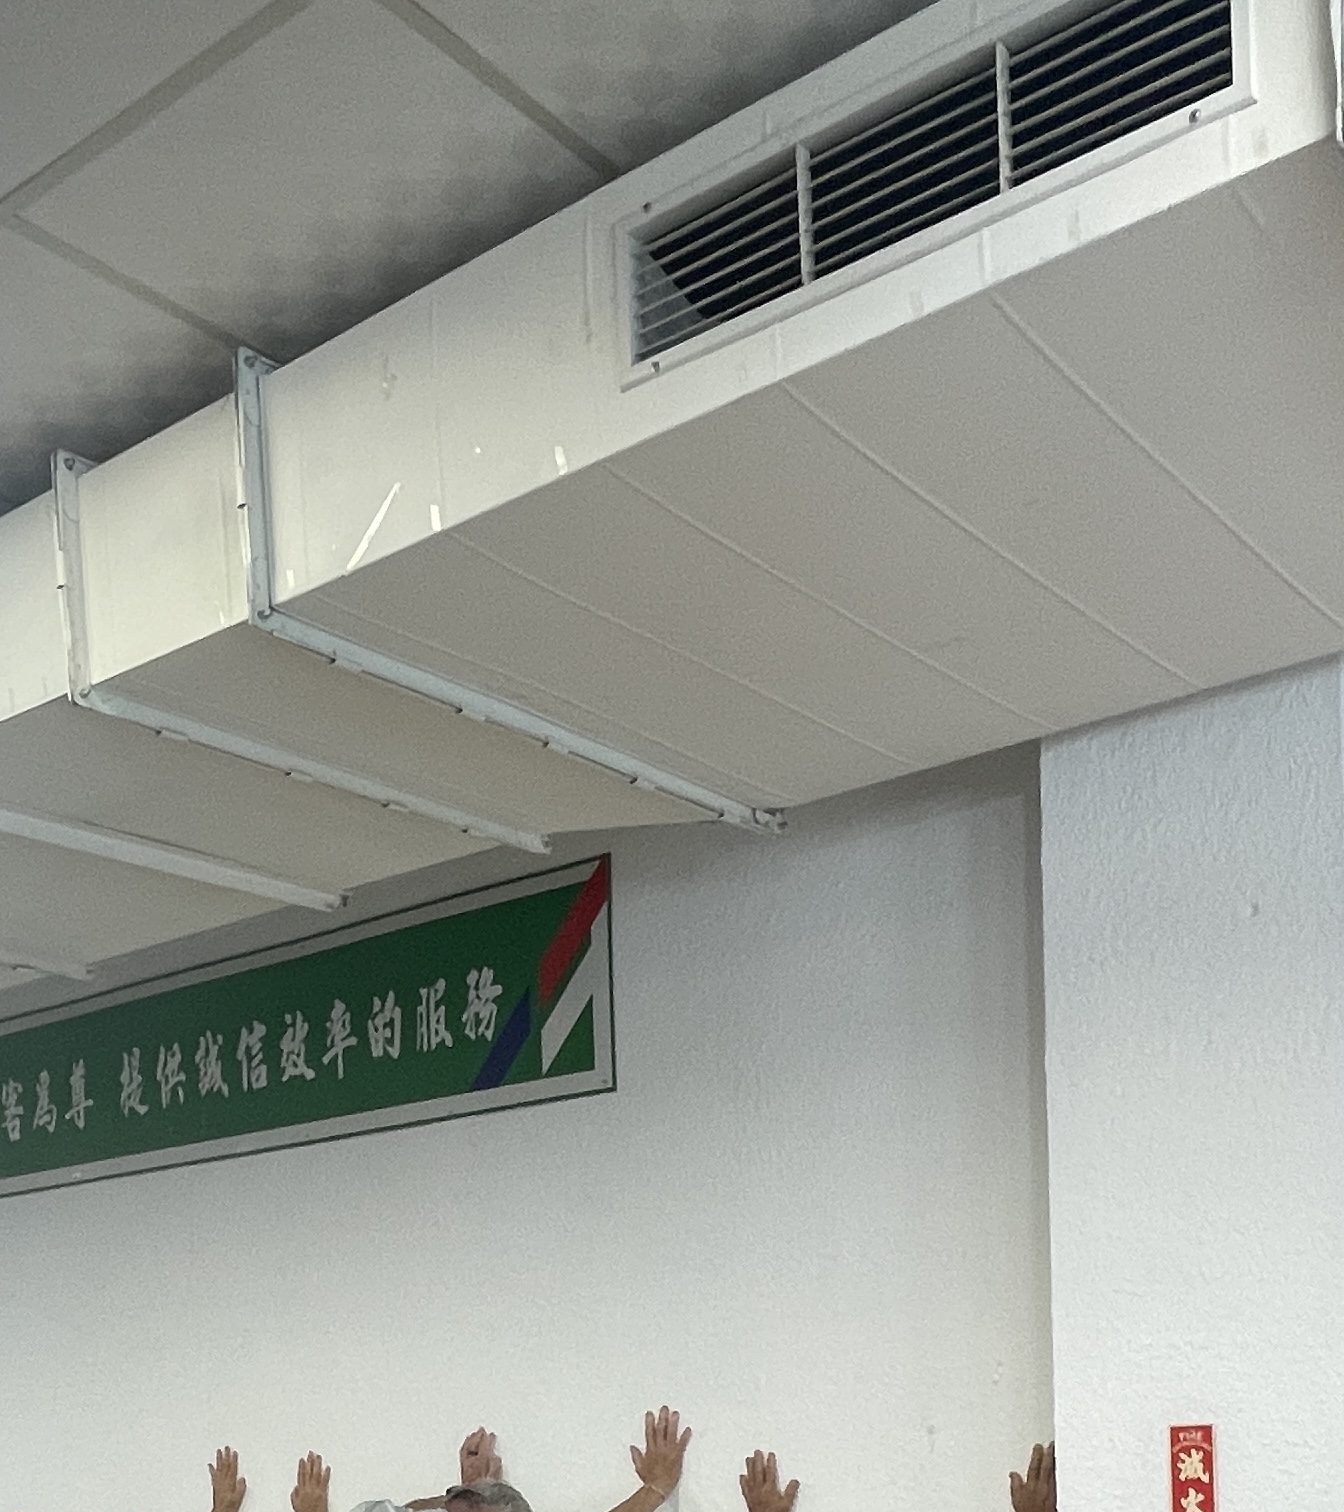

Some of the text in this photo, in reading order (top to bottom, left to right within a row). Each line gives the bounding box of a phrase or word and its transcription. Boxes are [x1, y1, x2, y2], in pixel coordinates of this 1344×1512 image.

[120, 966, 503, 1117] 提供誠信效率的服務
